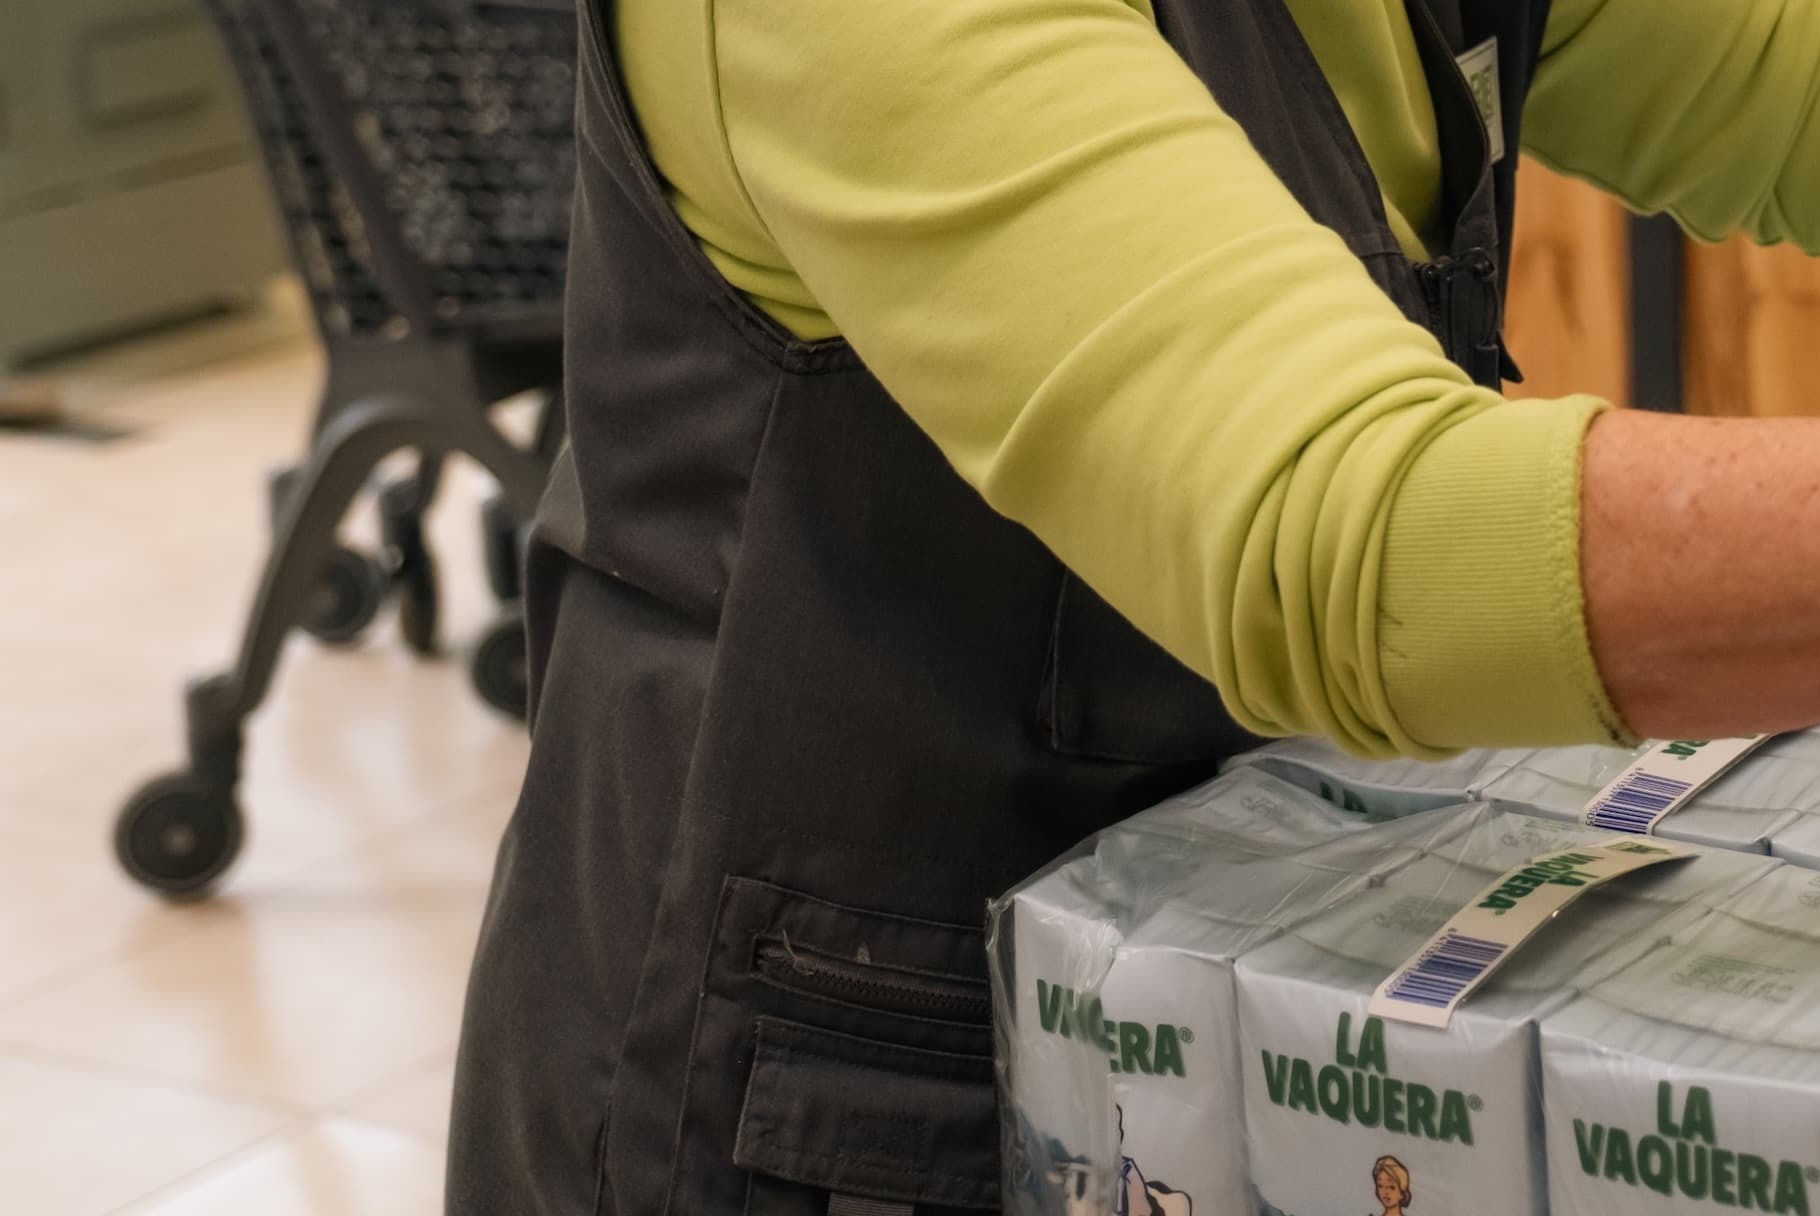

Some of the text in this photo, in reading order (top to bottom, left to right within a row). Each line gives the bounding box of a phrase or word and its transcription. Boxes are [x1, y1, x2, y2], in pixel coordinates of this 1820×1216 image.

[1477, 852, 1605, 911] VAQUERA
[1336, 1011, 1387, 1074] LA
[1657, 1079, 1716, 1145] LA
